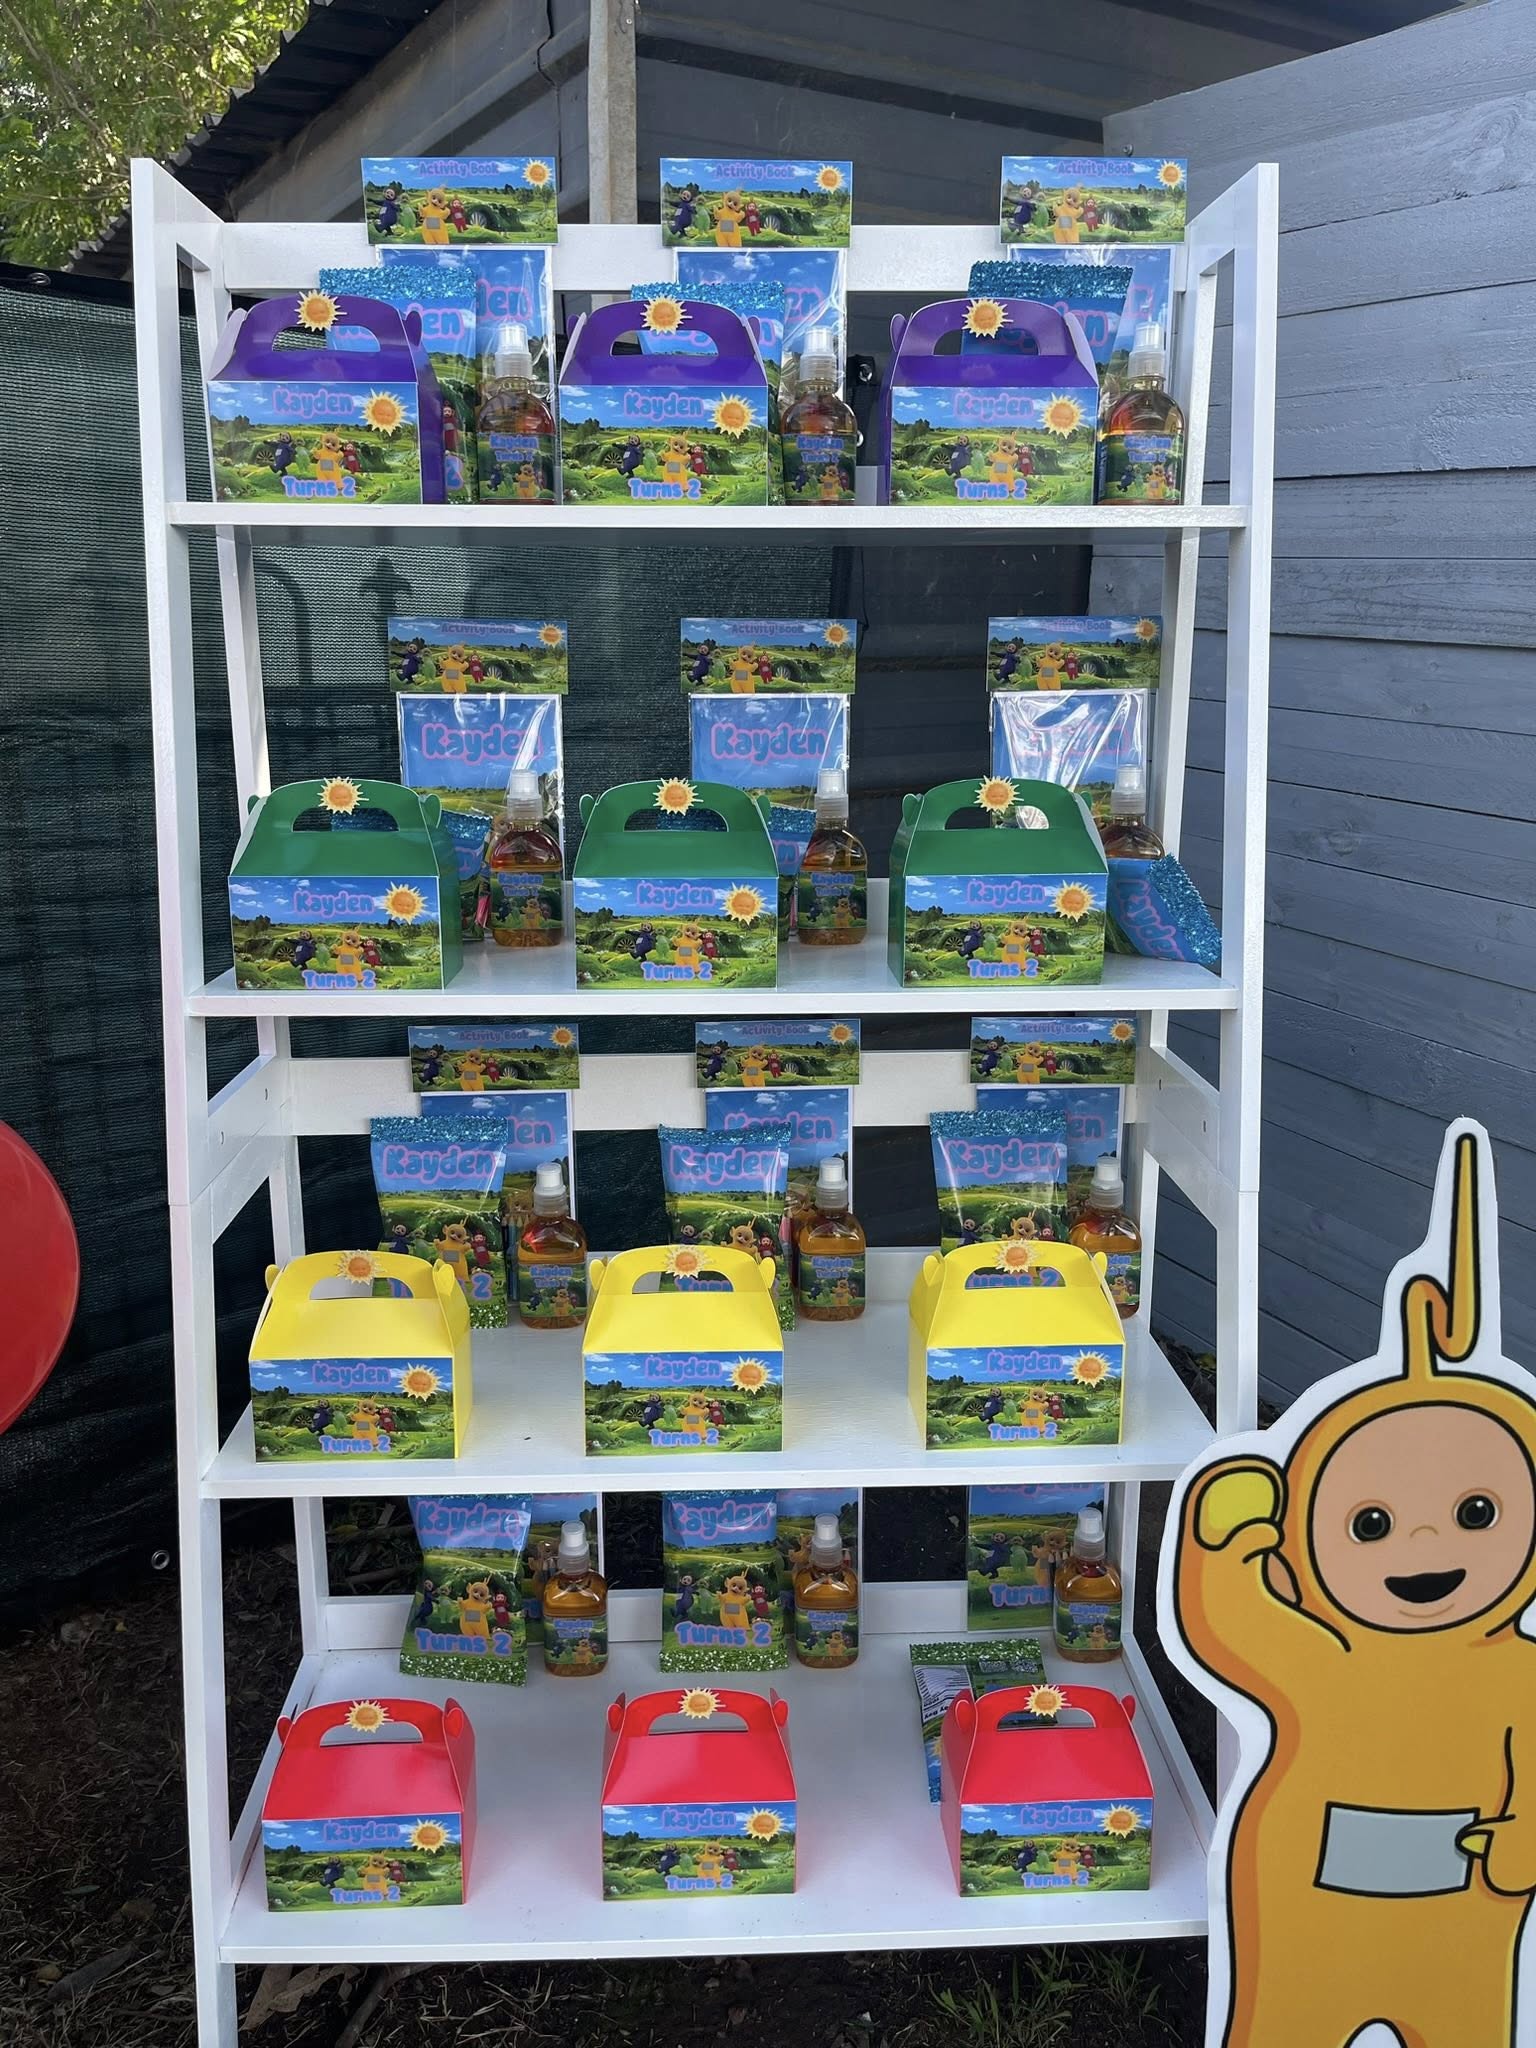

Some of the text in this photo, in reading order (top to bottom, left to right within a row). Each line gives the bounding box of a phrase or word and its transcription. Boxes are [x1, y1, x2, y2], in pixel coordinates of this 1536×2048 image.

[420, 160, 500, 177] Activity Book
[714, 163, 797, 180] Activity Book
[1056, 161, 1134, 177] Activity Book
[272, 389, 354, 418] Kayden
[624, 389, 704, 422] Kayden
[953, 392, 1034, 421] Kayden
[489, 434, 539, 450] Kayden
[797, 435, 844, 451] Kayden
[495, 450, 523, 462] Turns
[282, 476, 356, 498] Turns 2
[628, 478, 701, 500] Turns 2
[956, 479, 1027, 500] Turns 2
[441, 621, 487, 637] Activity
[731, 621, 777, 637] Activity
[711, 722, 830, 764] Kayden
[497, 873, 543, 887] Kayden
[811, 872, 855, 887] Kayden
[293, 890, 376, 919] Kayden
[636, 880, 716, 910] Kayden
[967, 880, 1048, 909] Kayden
[640, 961, 713, 981] Turns 2
[968, 958, 1039, 978] Turns 2
[302, 970, 376, 989] Turns 2
[459, 1029, 530, 1043] Activity Book
[742, 1023, 811, 1038] Activity Book
[1020, 1021, 1090, 1036] Activity Book
[383, 1145, 497, 1184] Kayden
[670, 1145, 781, 1186] Kayden
[944, 1138, 1060, 1179] Kayden
[530, 1266, 573, 1279] Kayden
[811, 1256, 853, 1269] Kayden
[645, 1355, 723, 1383] Kayden
[987, 1351, 1064, 1375] Kayden
[313, 1362, 392, 1388] Kayden
[649, 1428, 719, 1447] Turns 2
[988, 1422, 1059, 1441] Turns 2
[319, 1435, 392, 1453] Turns 2
[415, 1500, 522, 1538] Kayden
[670, 1500, 772, 1539] Kayden
[414, 1628, 514, 1656] Turns 2
[675, 1621, 773, 1648] Turns 2
[662, 1807, 736, 1831] Kayden
[1020, 1807, 1095, 1829] Kayden
[323, 1821, 400, 1844] Kayden
[665, 1873, 734, 1891] Turns 2
[1022, 1872, 1091, 1889] Turns 2
[330, 1886, 400, 1904] Turns 2
